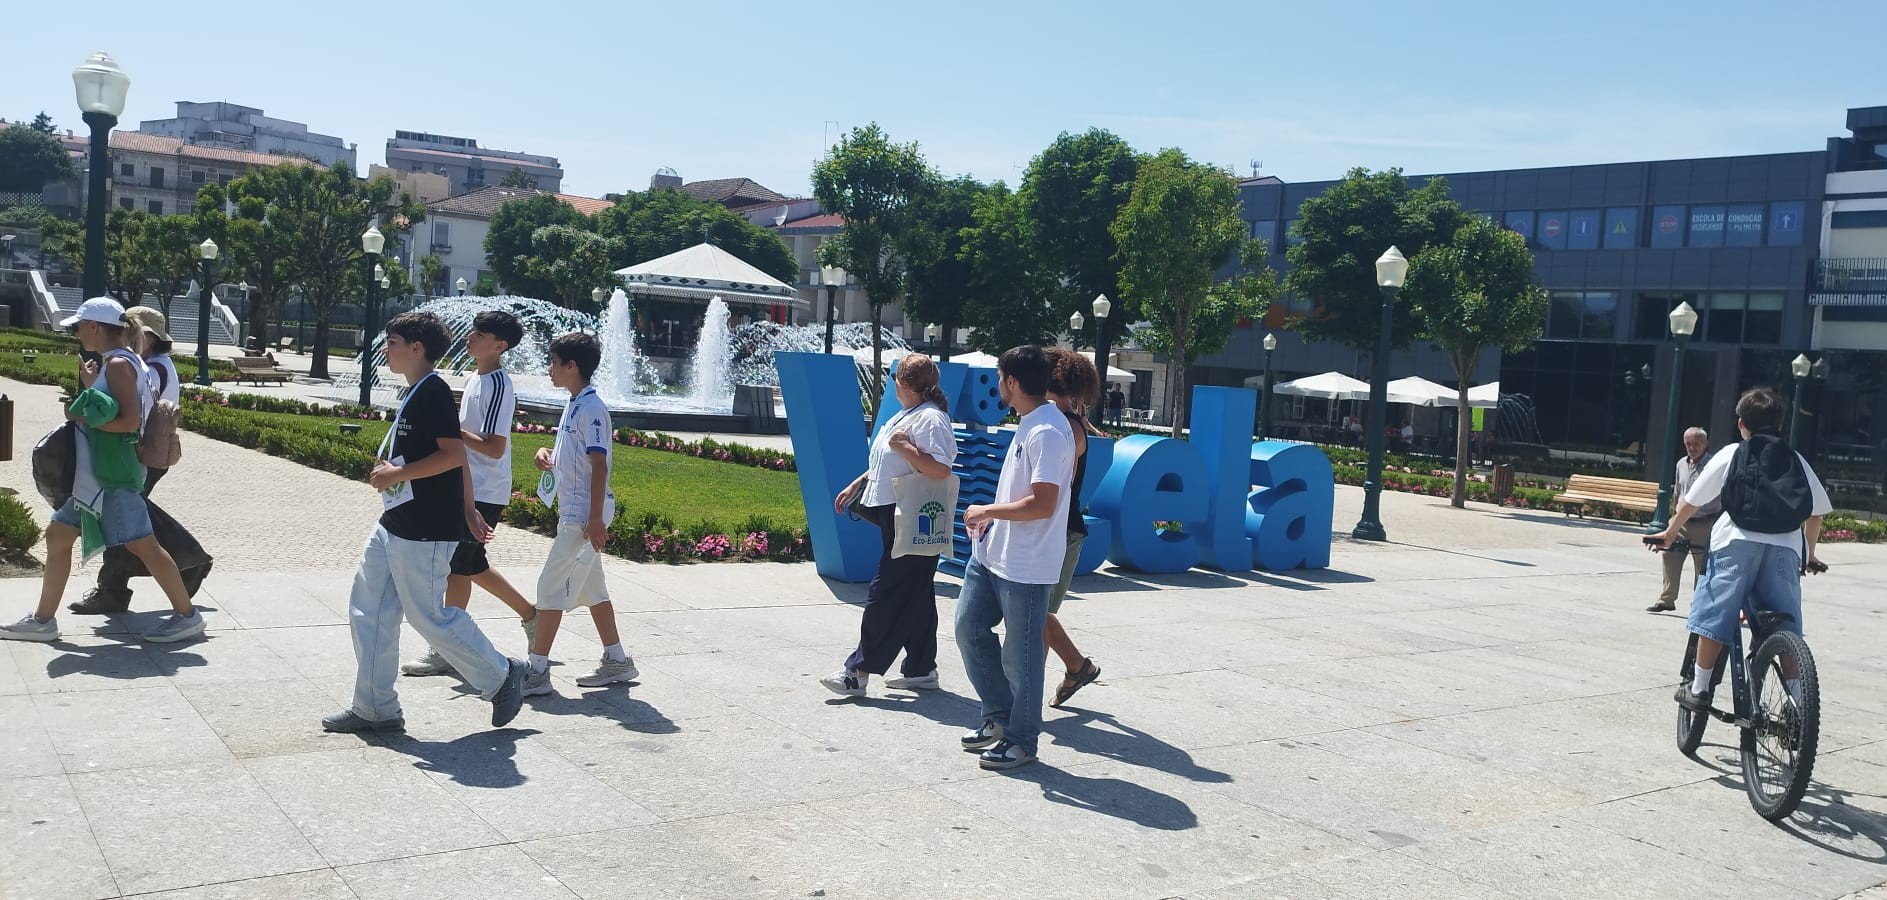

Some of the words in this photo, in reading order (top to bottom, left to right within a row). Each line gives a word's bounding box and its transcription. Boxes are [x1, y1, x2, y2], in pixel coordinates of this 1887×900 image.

[1692, 214, 1714, 222] ESCOLA
[1716, 214, 1725, 222] DE
[912, 535, 950, 545] Eco-Escolas
